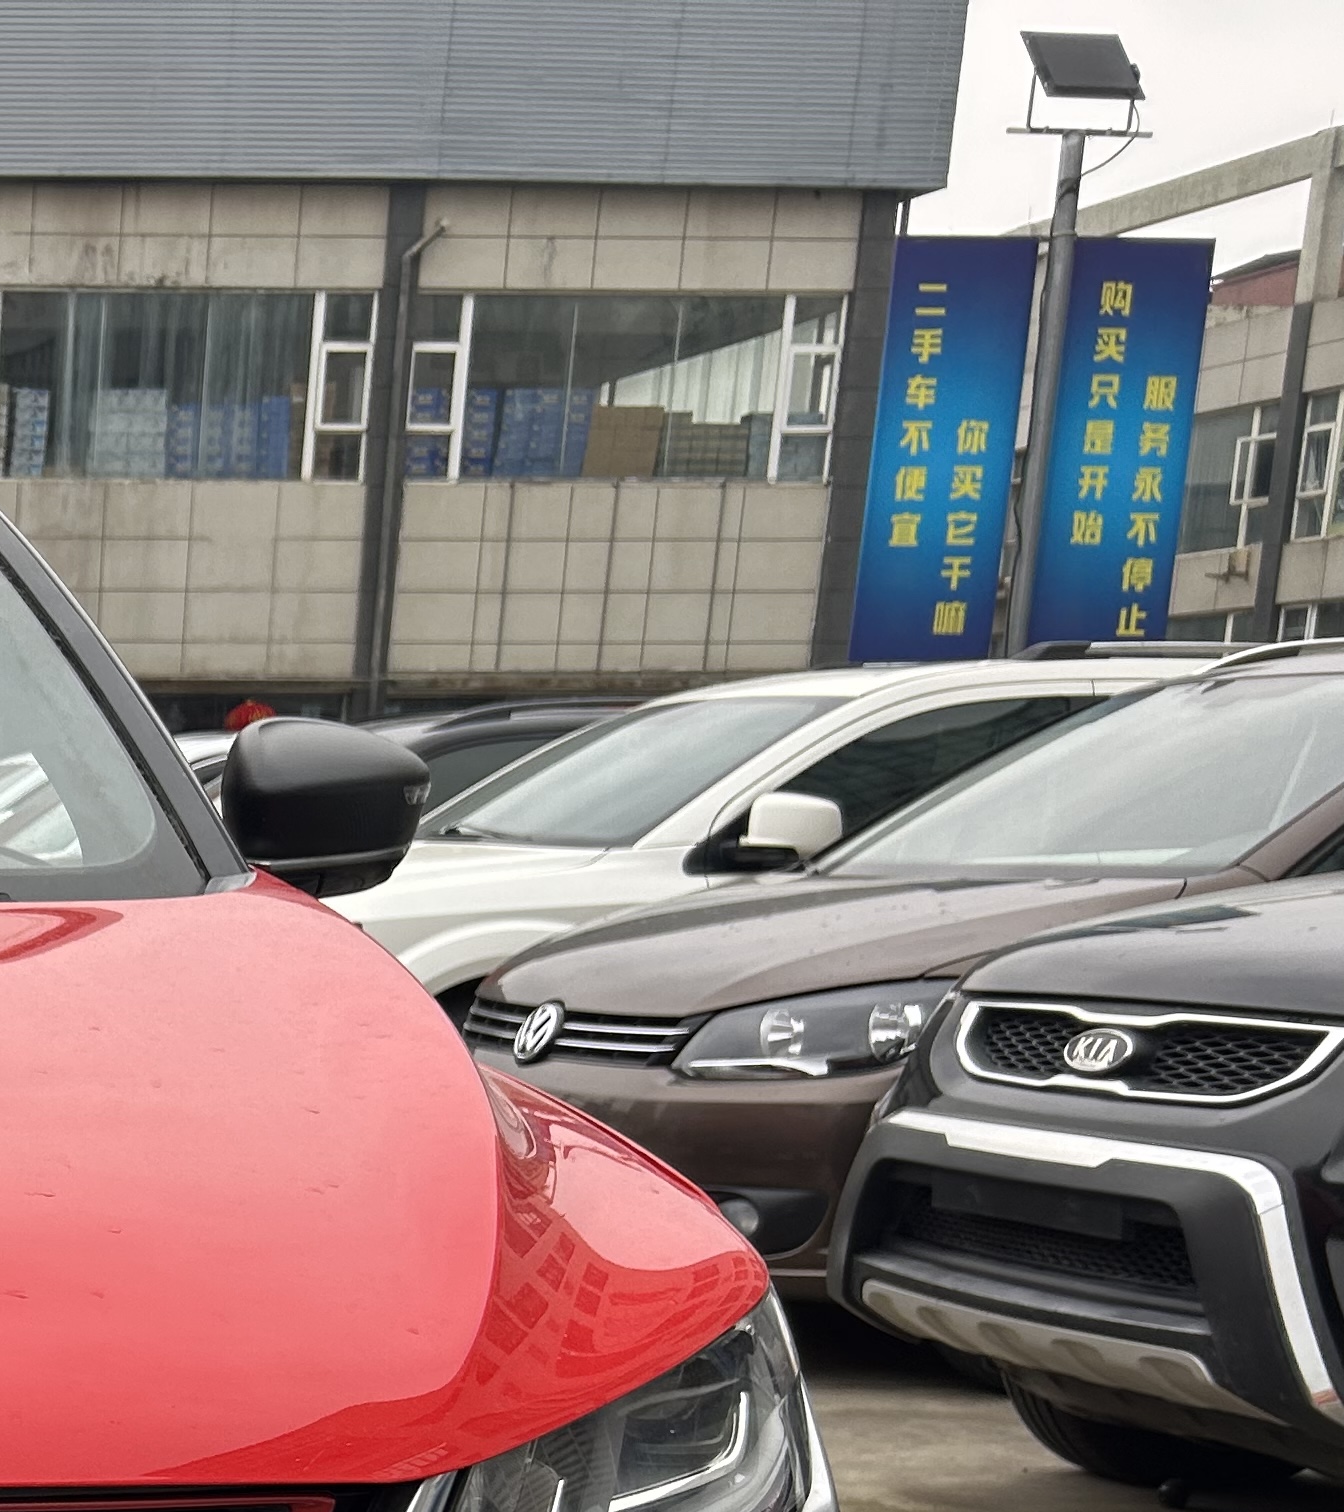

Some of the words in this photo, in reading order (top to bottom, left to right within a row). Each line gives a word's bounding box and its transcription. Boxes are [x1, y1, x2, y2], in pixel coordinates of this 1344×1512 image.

[889, 282, 947, 548] 二手车不便宜
[932, 419, 990, 636] 你买它干嘛
[1070, 280, 1133, 545] 购买只是开始
[1116, 375, 1177, 638] 服务永不停止
[1072, 1036, 1118, 1063] KIA
